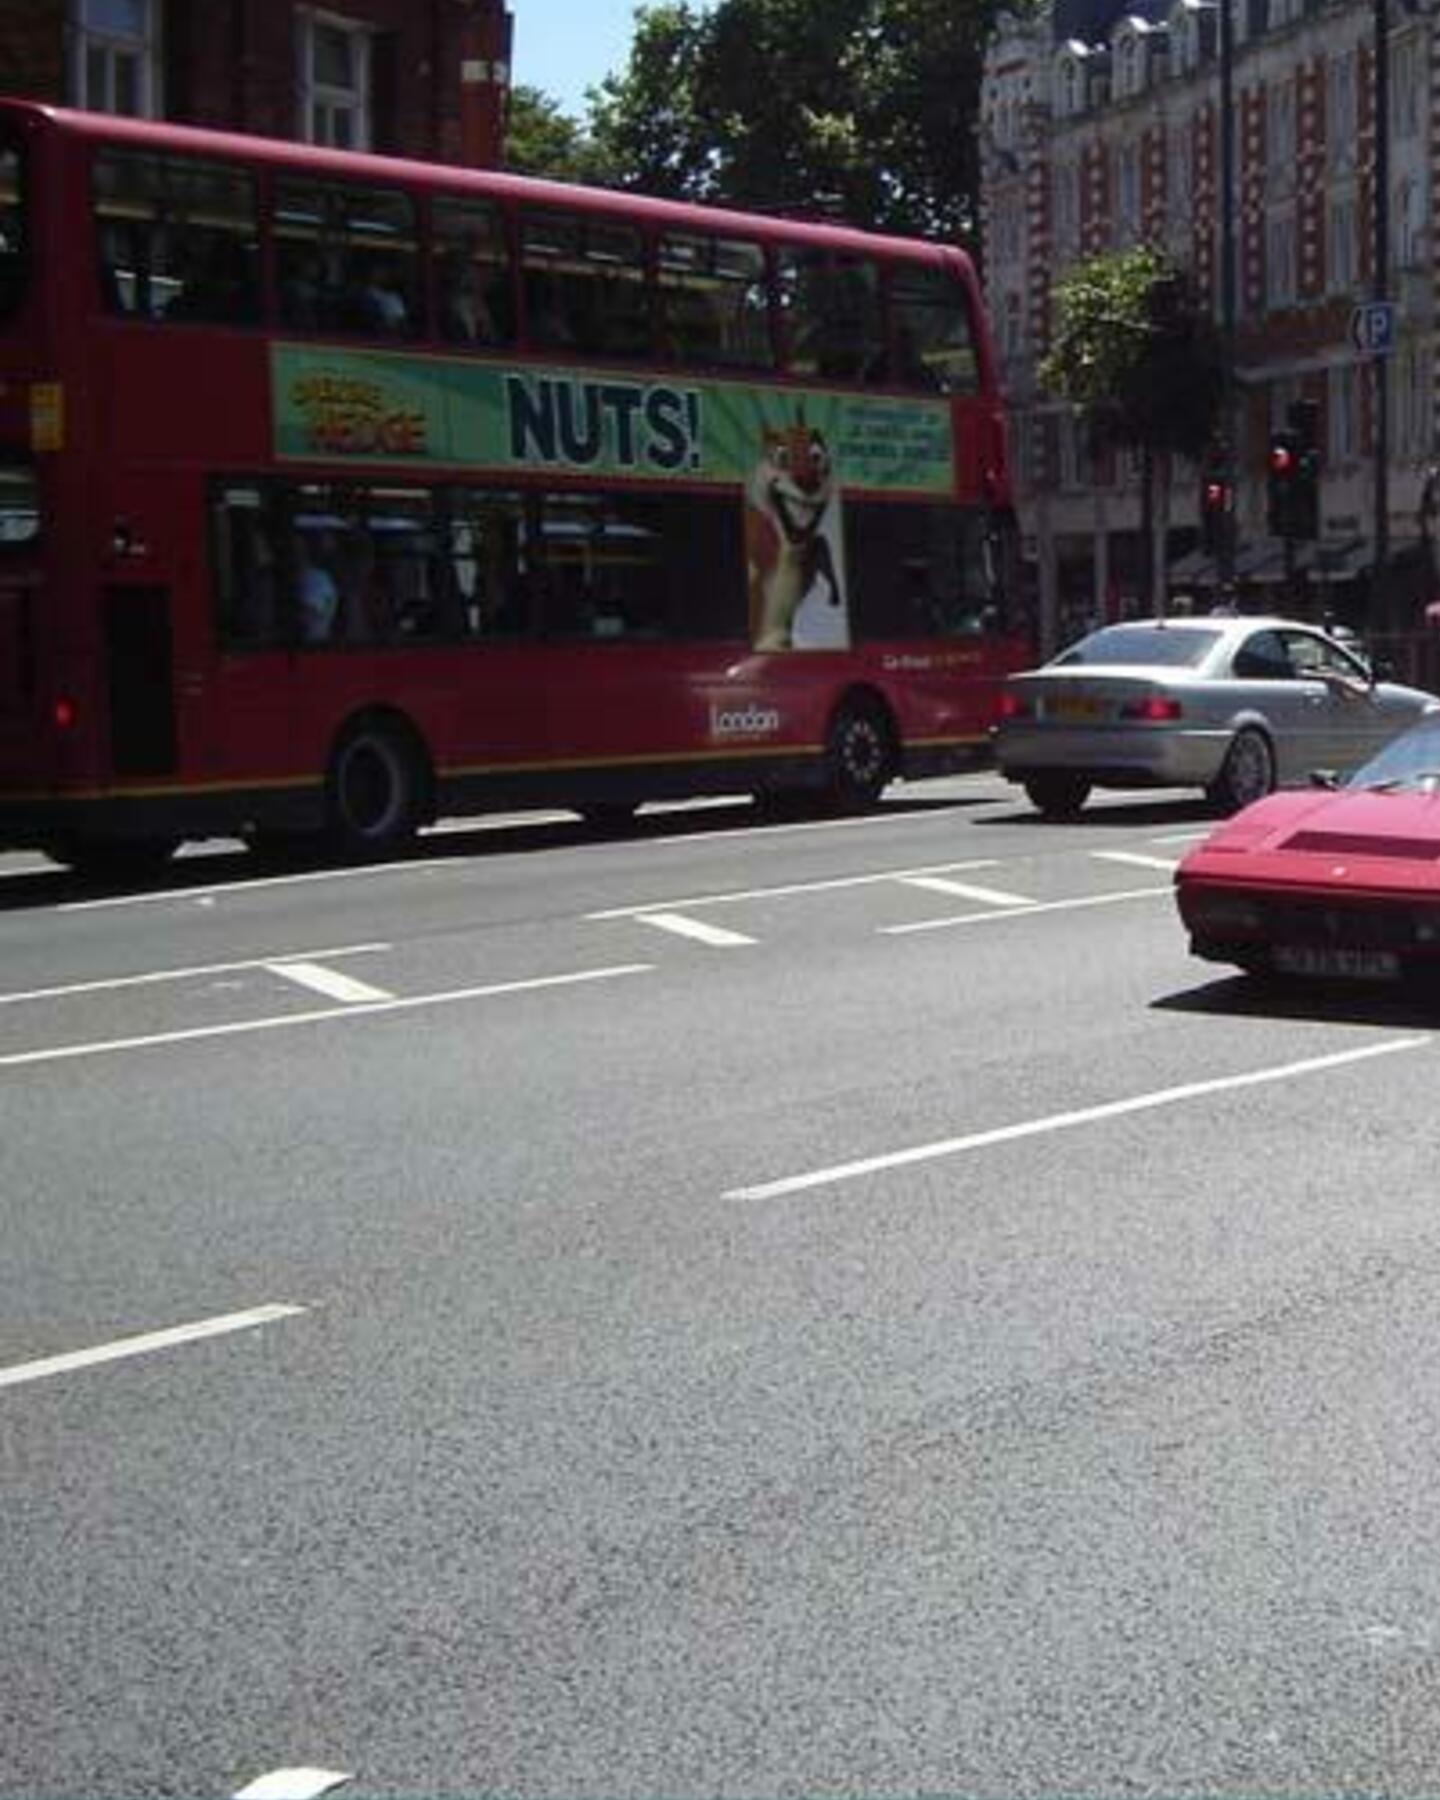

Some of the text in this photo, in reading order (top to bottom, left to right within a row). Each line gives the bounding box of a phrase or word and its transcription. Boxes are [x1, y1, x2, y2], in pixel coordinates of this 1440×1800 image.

[1370, 311, 1388, 343] P
[506, 376, 700, 470] NUTS!
[709, 701, 779, 738] London
